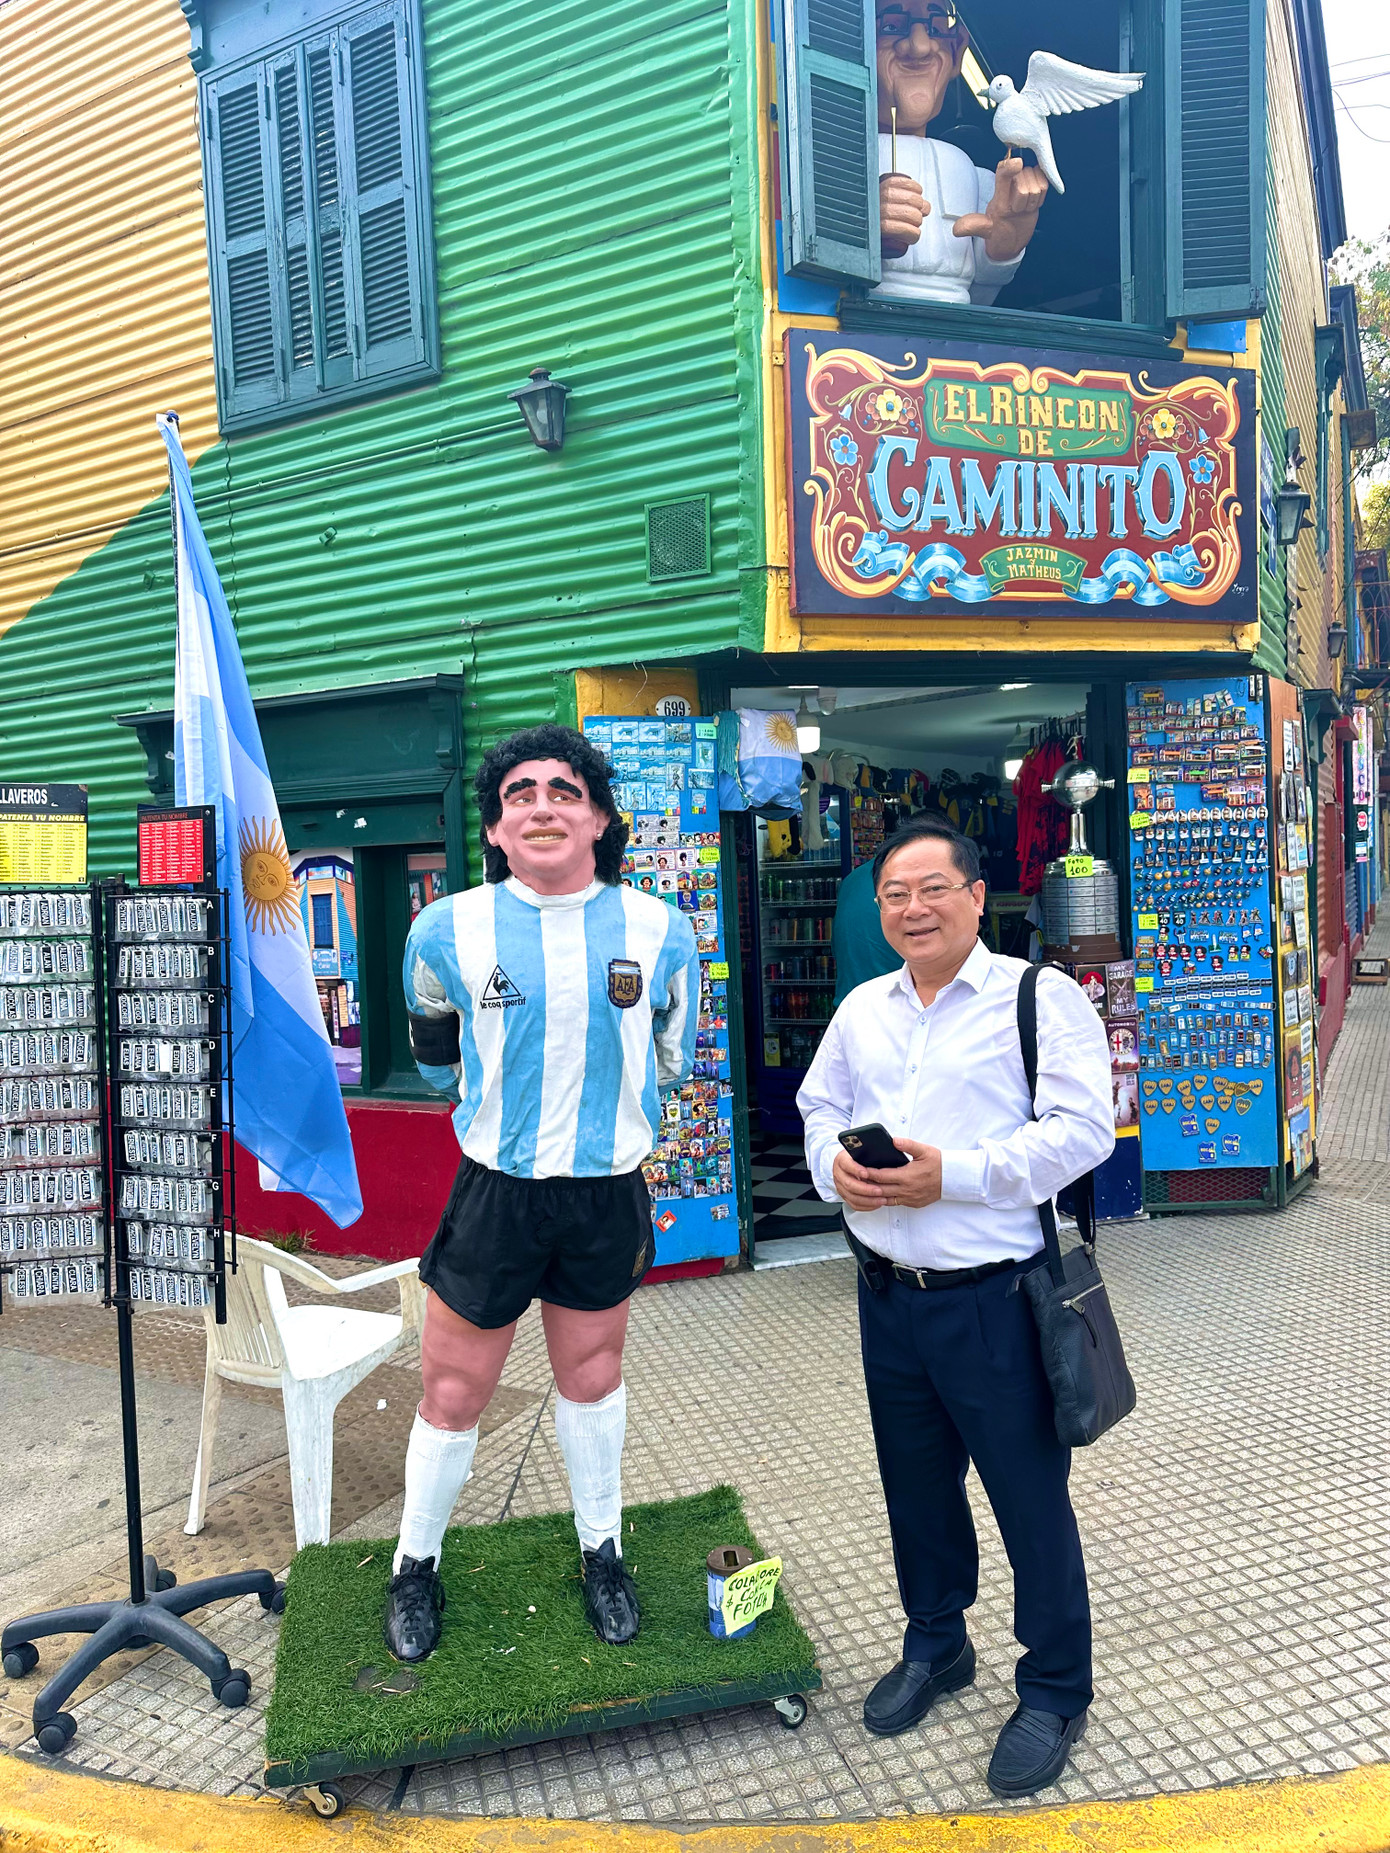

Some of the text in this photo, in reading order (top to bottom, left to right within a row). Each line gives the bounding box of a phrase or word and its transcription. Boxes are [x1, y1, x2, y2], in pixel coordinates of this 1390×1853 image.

[944, 384, 1119, 432] EL RINCON
[1018, 429, 1054, 457] DE
[866, 435, 1187, 540] CAMINITO
[1006, 548, 1058, 562] JAZMIN
[1007, 564, 1061, 579] MATHEUS
[664, 700, 685, 716] 699
[0, 788, 48, 804] LAVEROS
[1070, 866, 1088, 875] 100
[40, 903, 50, 925] ADRIAN
[58, 900, 66, 926] ADRIANA
[189, 905, 197, 931] CLAUDIA
[23, 952, 31, 970] AILEN
[43, 952, 52, 969] ALAN
[59, 948, 68, 973] ALBERTO
[146, 955, 154, 975] DANTE
[158, 952, 166, 978] DANIELA
[616, 974, 634, 995] AFA
[1109, 970, 1133, 980] GARAGE
[7, 994, 17, 1020] NICOLAS
[27, 994, 36, 1020] ALFREDO
[43, 997, 52, 1016] ALICIA
[60, 998, 68, 1012] ANA
[480, 996, 526, 1009] le coq sportif
[1112, 1004, 1135, 1014] RULES
[12, 1042, 20, 1065] ANALIA
[28, 1040, 36, 1064] ANDREA
[76, 1037, 84, 1062] ANGELA
[147, 1049, 155, 1069] ELENA
[186, 1046, 195, 1074] EDGARDO
[46, 1085, 54, 1110] ANTONIO
[30, 1131, 38, 1156] BAUTISTA
[50, 1131, 58, 1156] BEATRIZ
[128, 1136, 136, 1161] ERNESTO
[14, 1179, 23, 1203] BRENDA
[32, 1182, 40, 1200] BRIAN
[47, 1181, 55, 1200] BRISA
[65, 1178, 73, 1199] BRUNO
[82, 1176, 91, 1199] CAMILA
[151, 1184, 159, 1208] ESTHER
[190, 1186, 199, 1213] ESTEBAN
[34, 1223, 43, 1248] CARLOS
[51, 1222, 59, 1248] CARMEN
[84, 1220, 92, 1245] CATALINA
[152, 1230, 162, 1256] FABIANA
[18, 1271, 26, 1296] CELESTE
[35, 1272, 45, 1295] CHIARA
[51, 1272, 59, 1291] CINTIA
[69, 1270, 77, 1291] CLARA
[85, 1267, 93, 1292] CLARISA
[144, 1278, 152, 1298] FLAVIA
